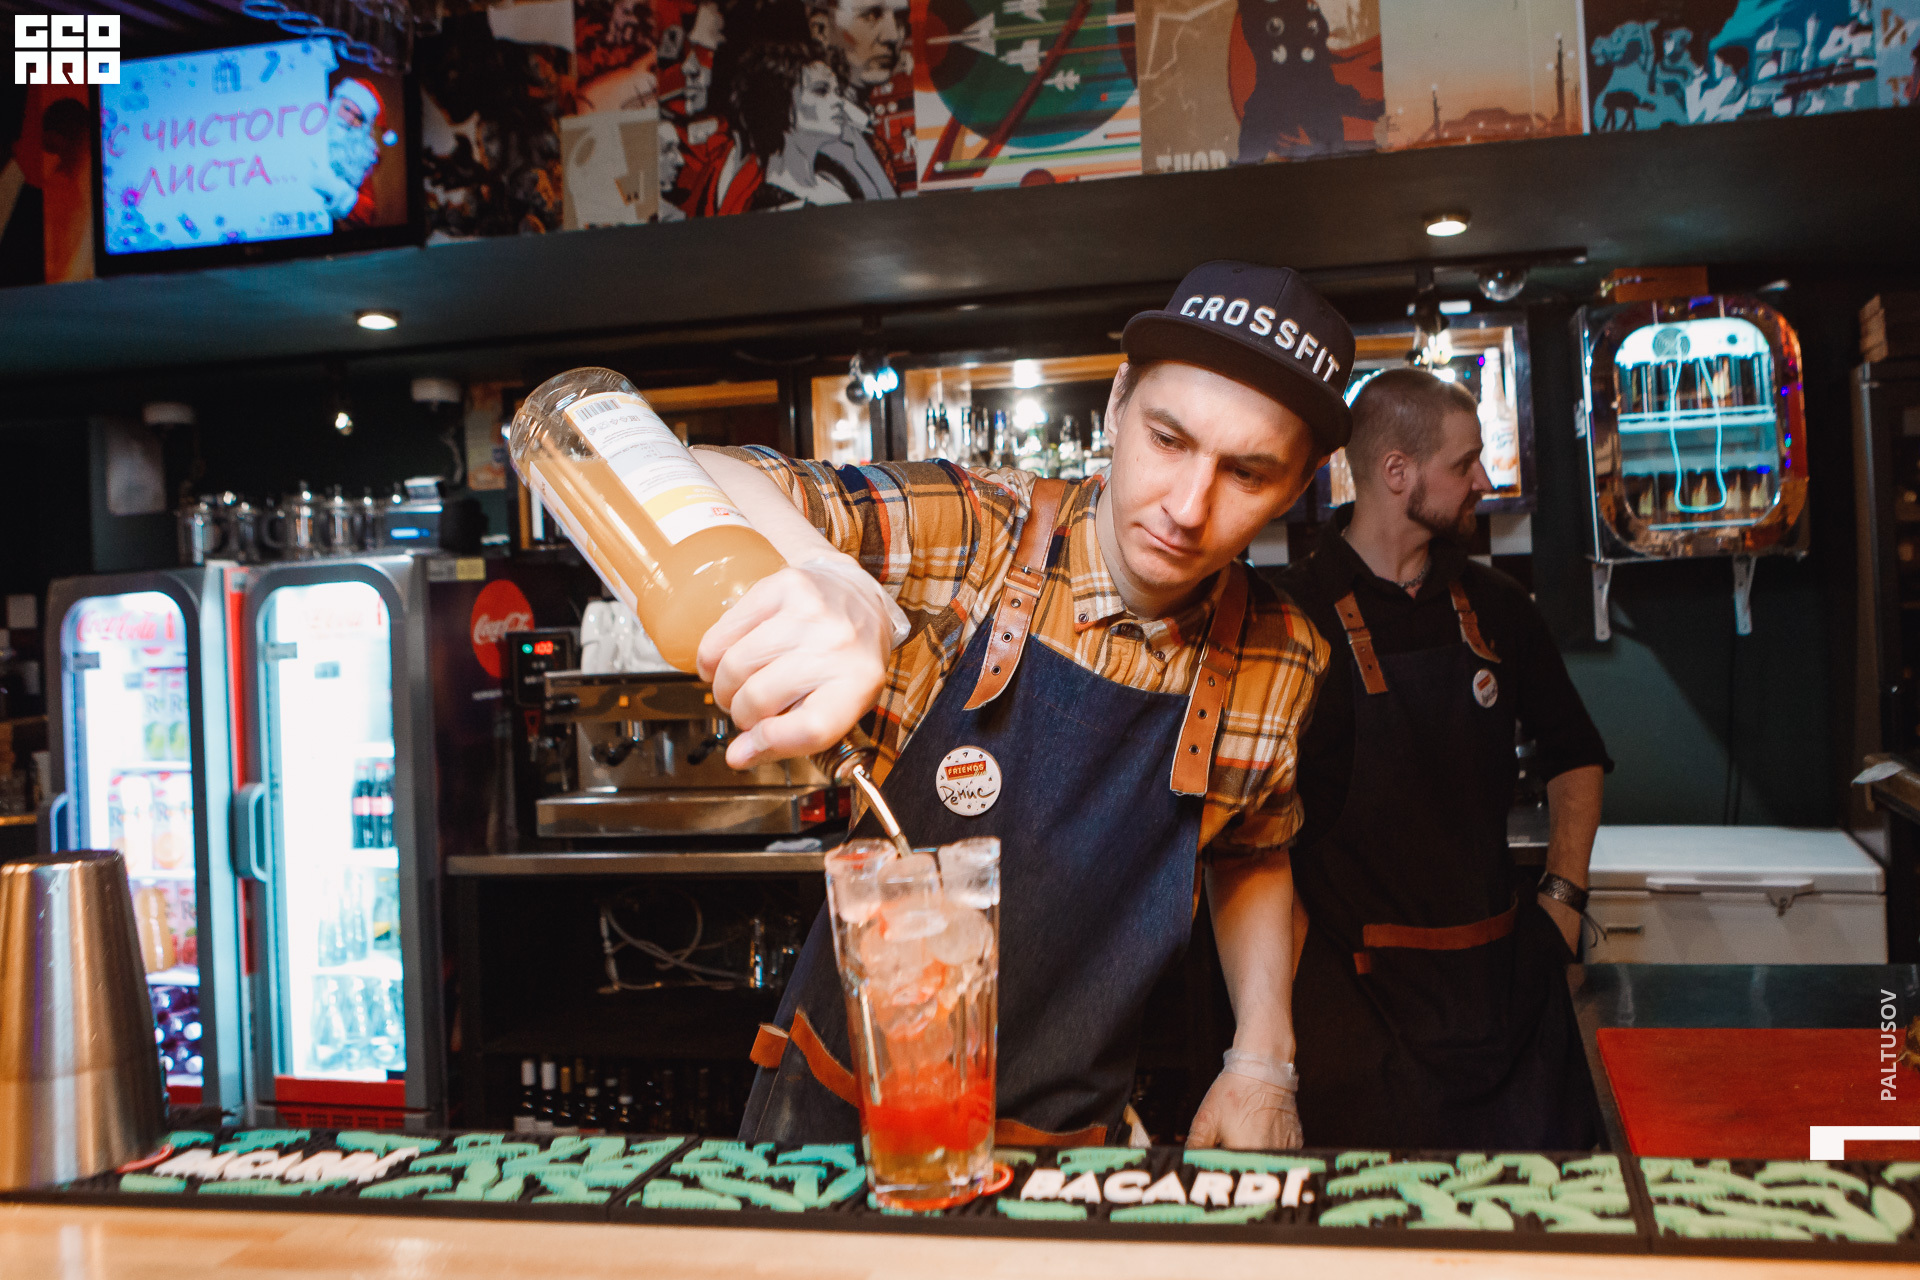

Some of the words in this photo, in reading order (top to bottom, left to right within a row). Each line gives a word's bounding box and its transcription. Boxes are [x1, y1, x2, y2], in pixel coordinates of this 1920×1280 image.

[107, 123, 130, 157] С
[143, 102, 329, 151] ЧИСТОГО
[1180, 295, 1341, 383] CROSSFIT
[947, 763, 985, 776] FRIENDS
